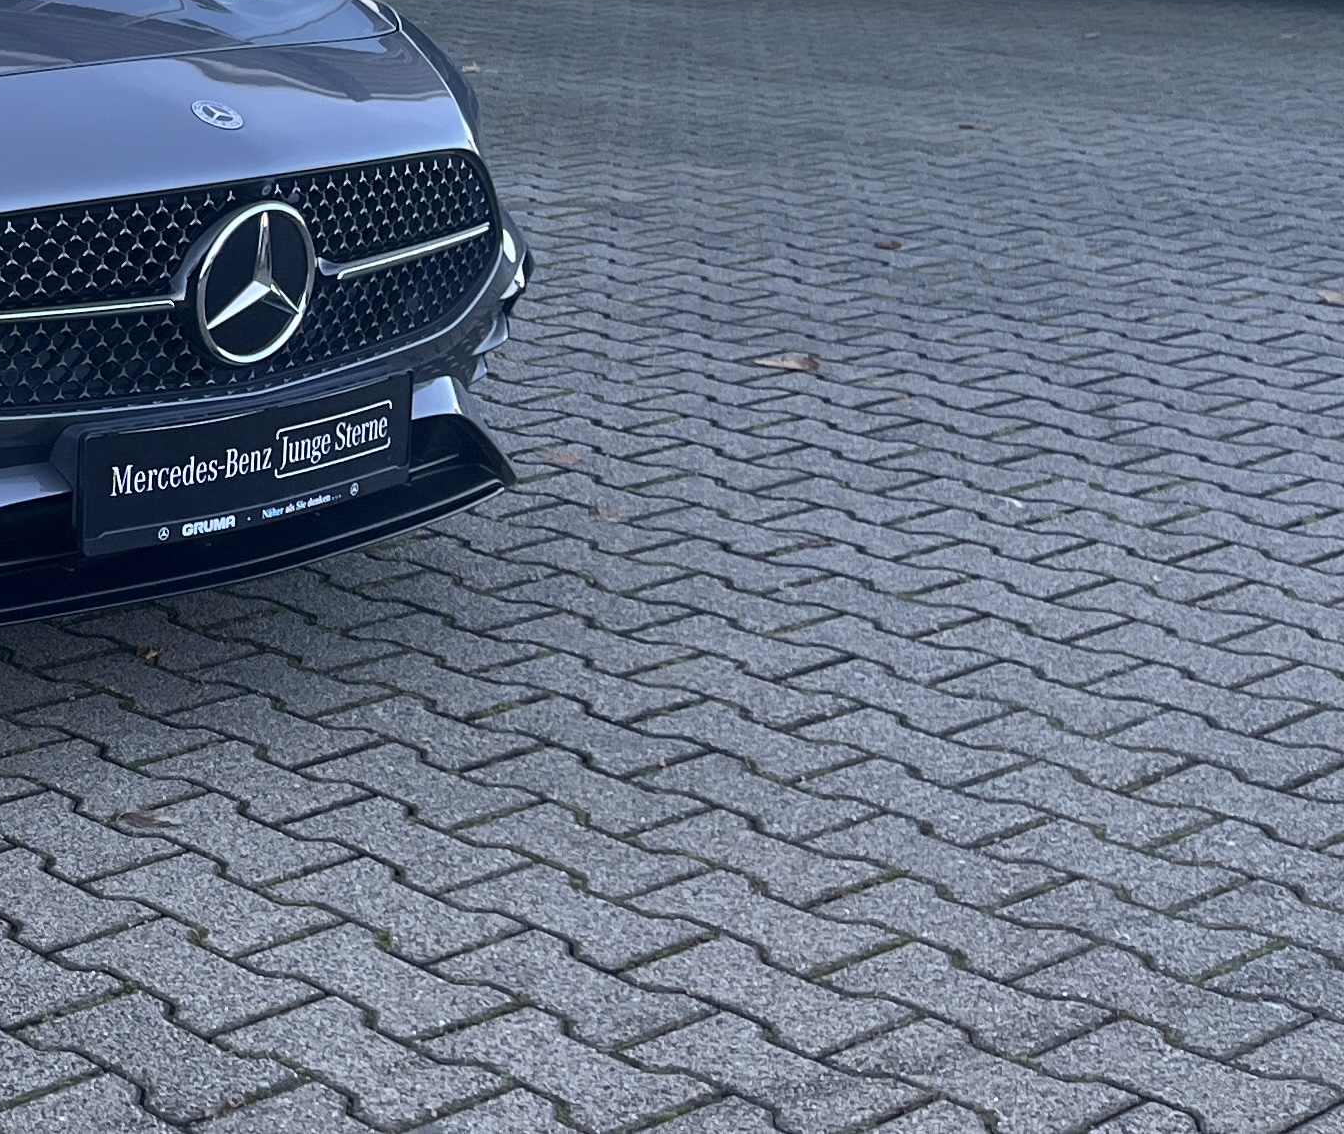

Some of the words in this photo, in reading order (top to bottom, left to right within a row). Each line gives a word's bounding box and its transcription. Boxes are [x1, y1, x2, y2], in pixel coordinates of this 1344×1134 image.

[110, 447, 272, 497] Mercedes-Benz
[280, 433, 331, 470] Junge
[334, 416, 388, 451] Sterne
[181, 515, 236, 537] GRUMA
